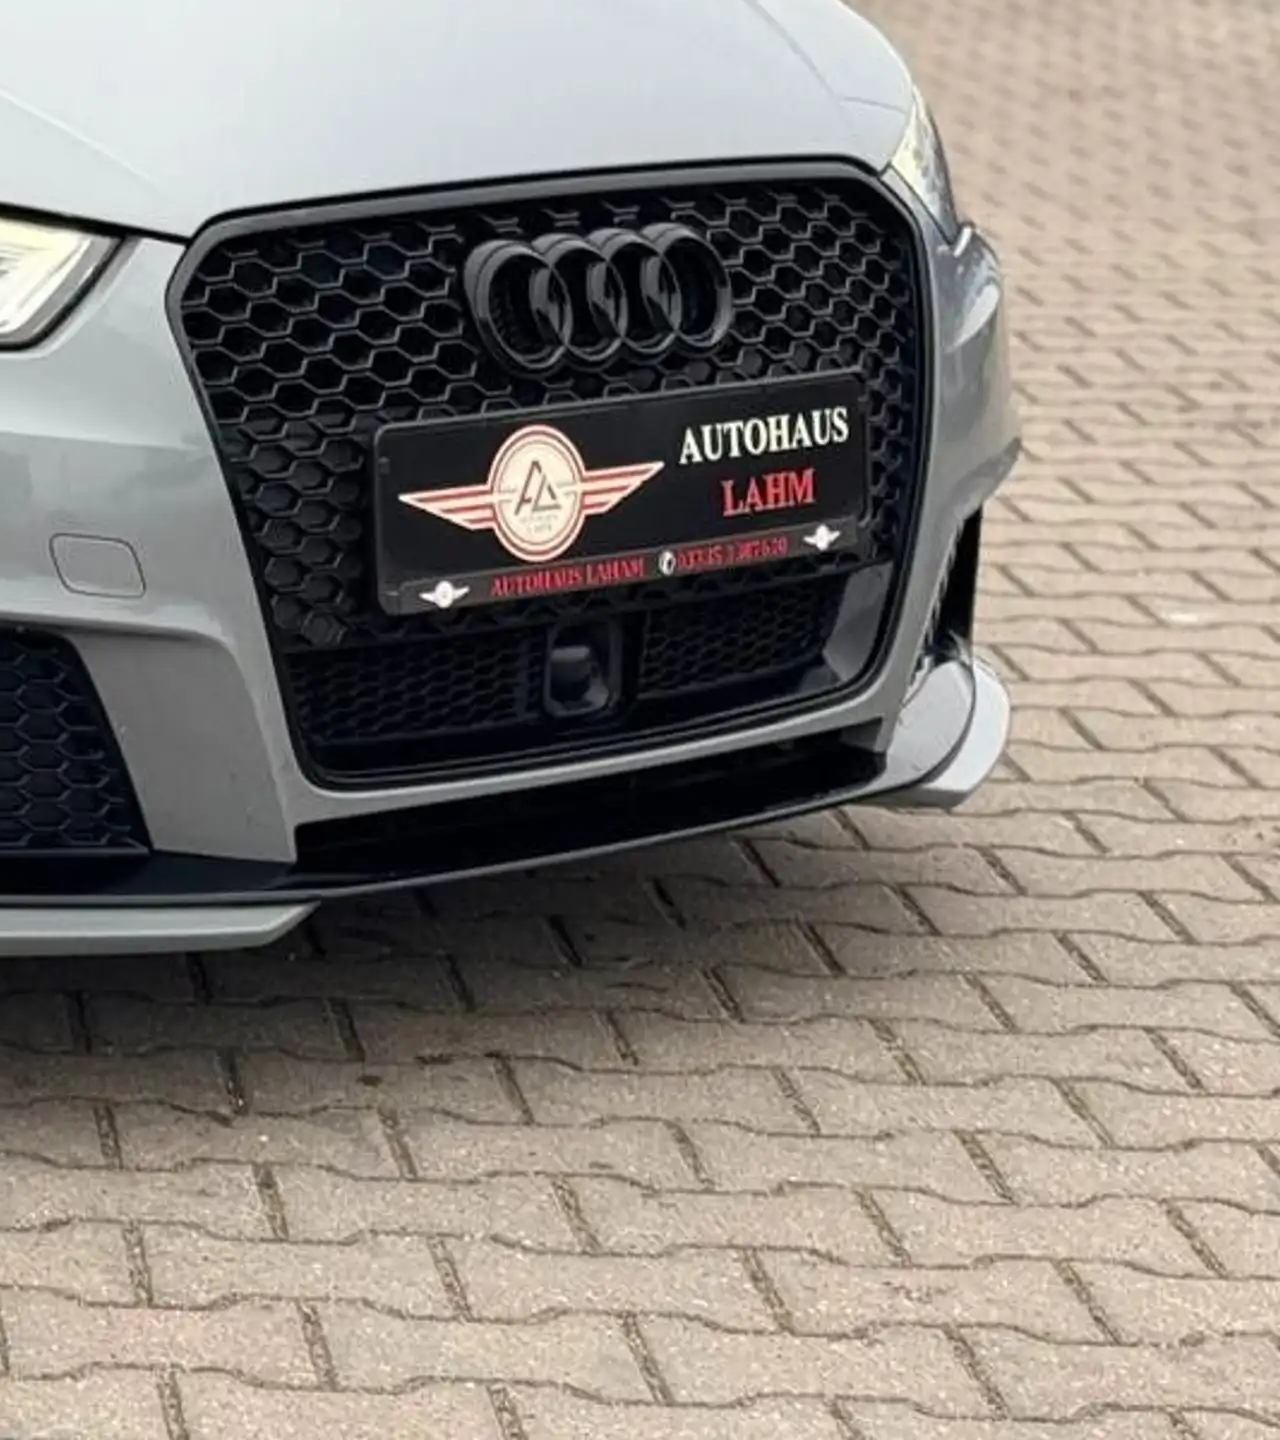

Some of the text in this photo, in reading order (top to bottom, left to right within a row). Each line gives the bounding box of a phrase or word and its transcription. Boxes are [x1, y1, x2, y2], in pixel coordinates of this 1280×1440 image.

[679, 405, 849, 465] AUTOHAUS
[720, 467, 817, 517] LAHM
[491, 557, 646, 597] AUTOHAUS LAHAM
